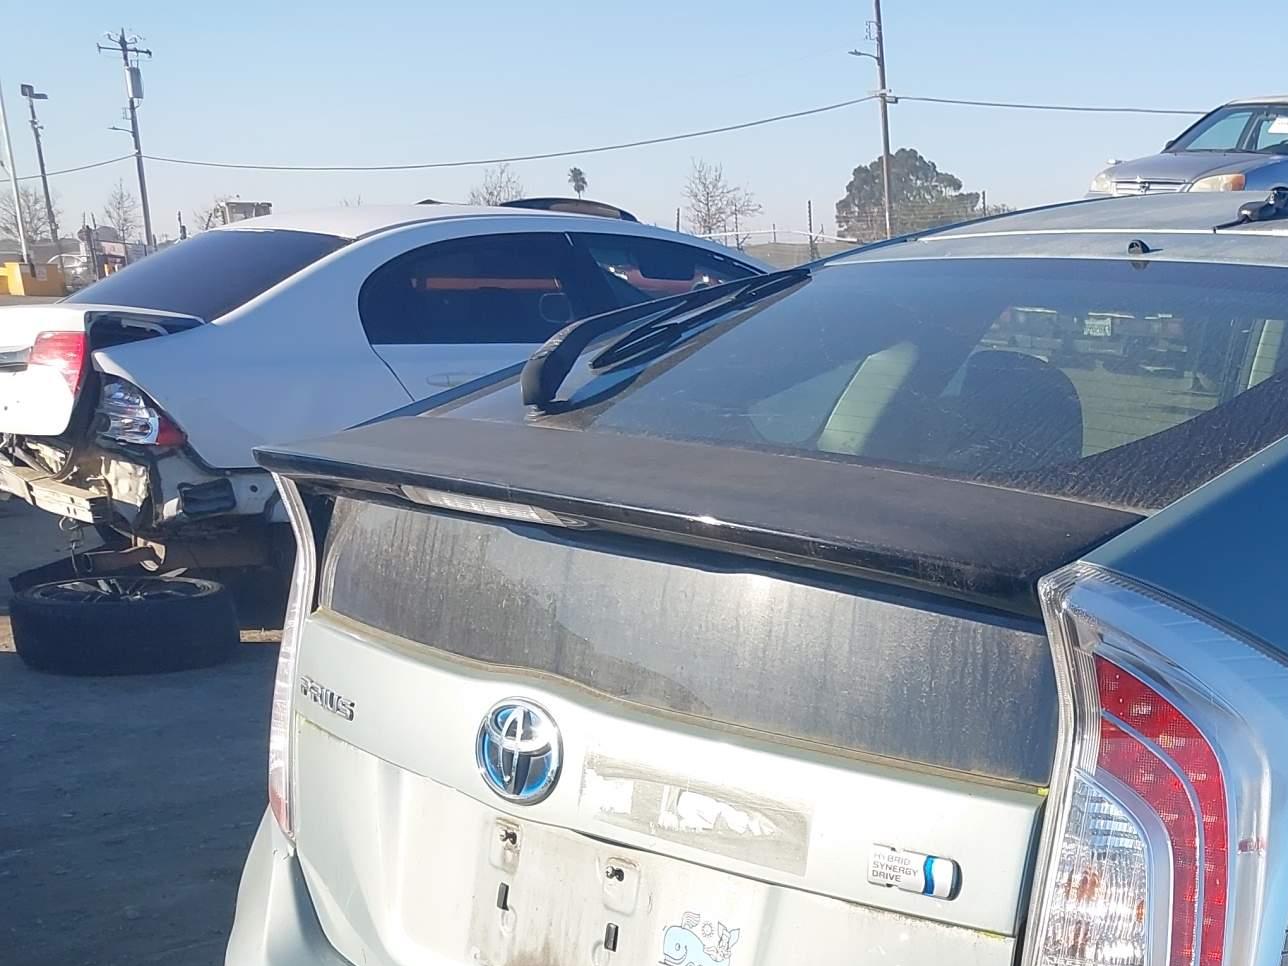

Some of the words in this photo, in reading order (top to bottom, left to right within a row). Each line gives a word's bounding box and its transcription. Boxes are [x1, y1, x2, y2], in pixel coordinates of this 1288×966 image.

[300, 675, 355, 721] PRIUS
[873, 851, 911, 866] HYBRID
[871, 869, 902, 883] DRIVE
[872, 860, 918, 877] SYNERGY
